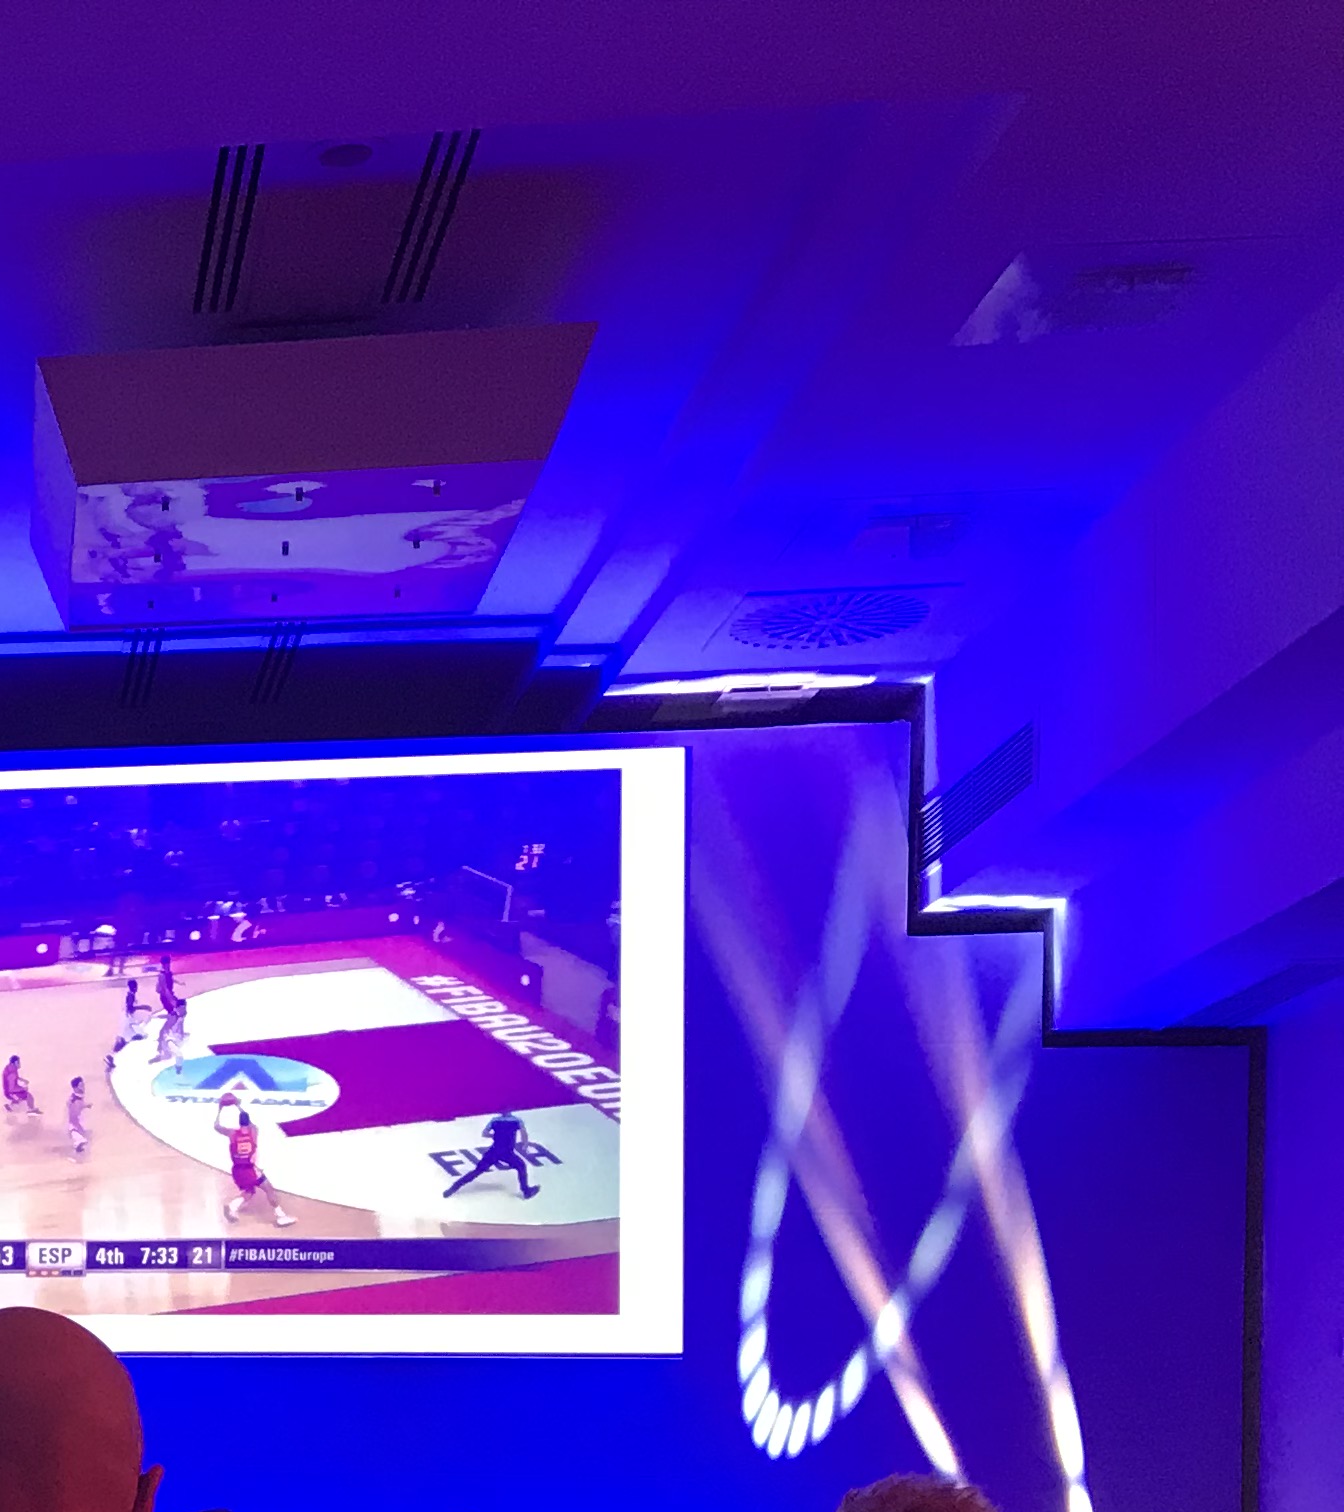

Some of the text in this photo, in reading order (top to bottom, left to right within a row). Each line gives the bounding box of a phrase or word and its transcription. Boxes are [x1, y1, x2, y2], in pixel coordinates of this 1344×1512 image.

[37, 1248, 73, 1265] ESP
[94, 1247, 125, 1266] 4th
[140, 1247, 179, 1266] 7:33
[191, 1247, 213, 1266] 21
[228, 1247, 336, 1264] #FIBAU20Europe
